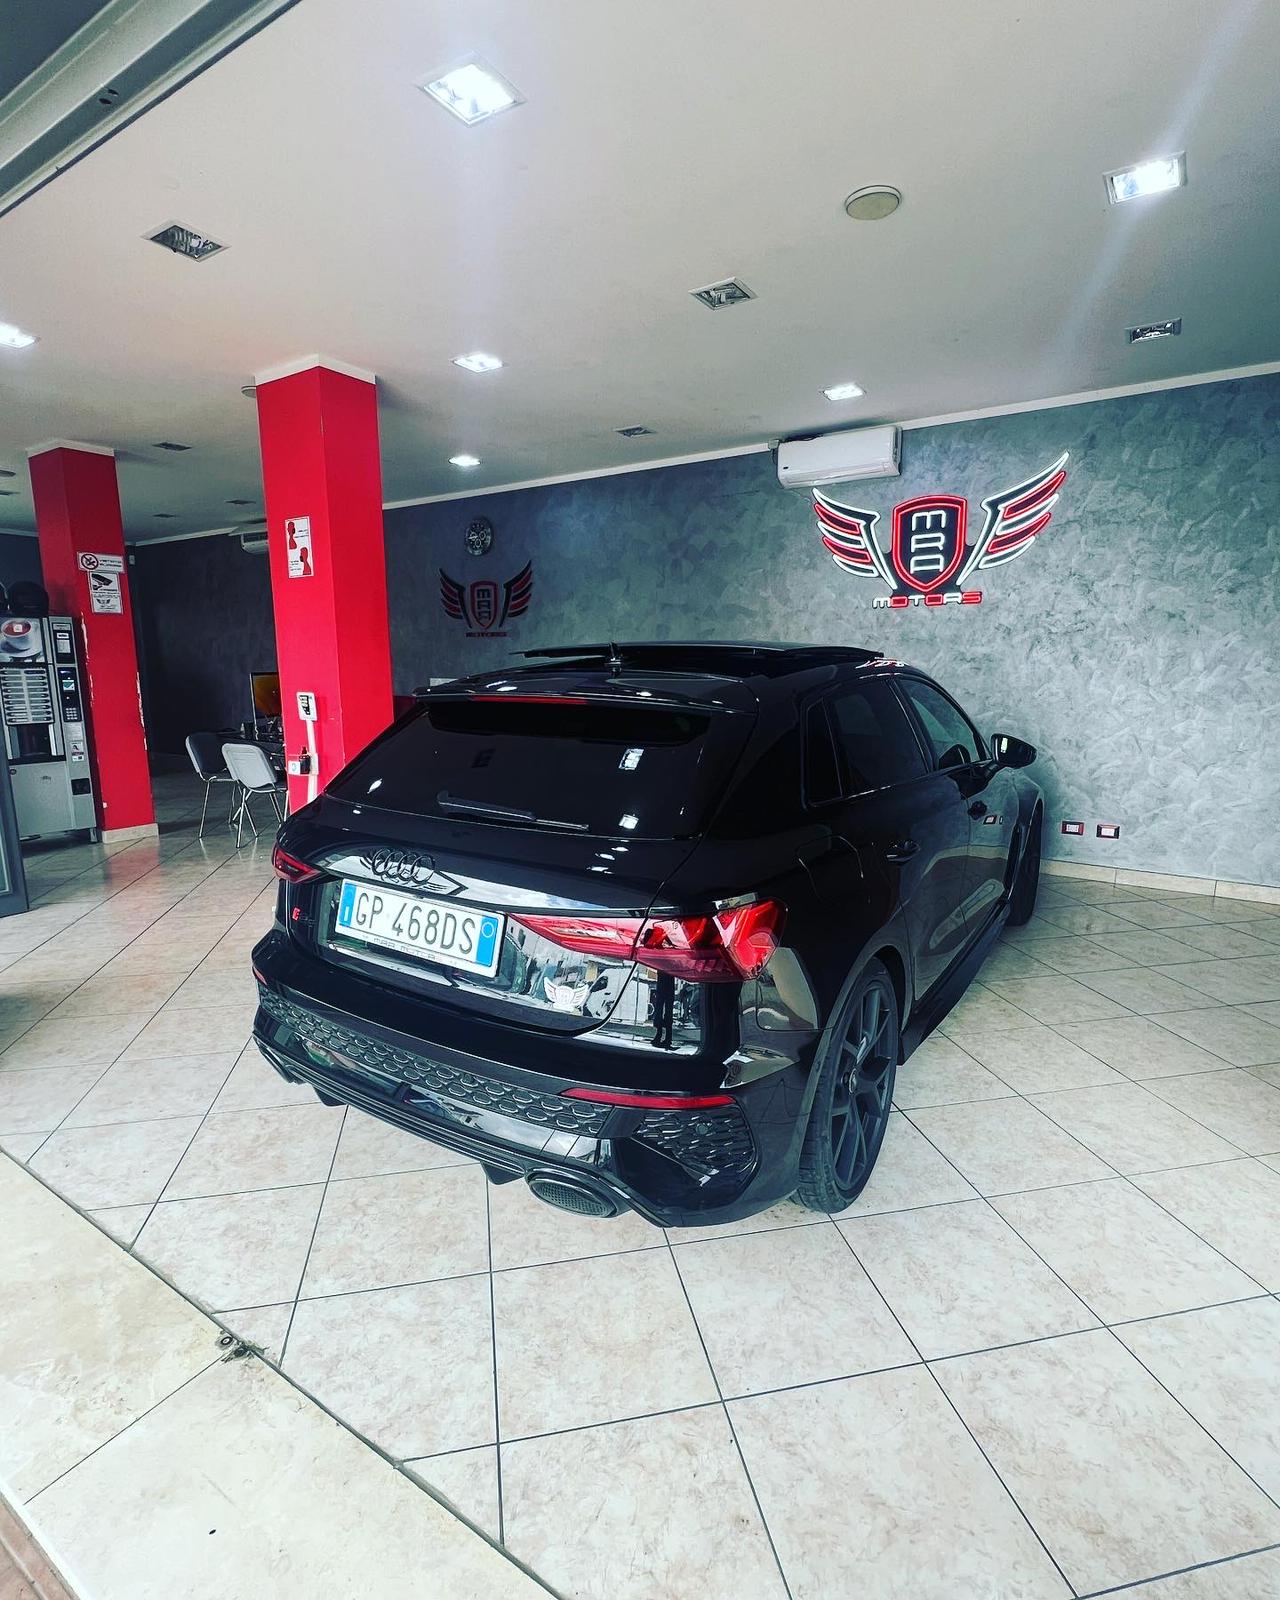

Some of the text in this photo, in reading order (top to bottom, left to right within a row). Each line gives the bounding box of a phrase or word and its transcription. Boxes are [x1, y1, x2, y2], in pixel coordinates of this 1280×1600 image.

[911, 510, 946, 574] MRA
[872, 591, 982, 608] MOTORS
[356, 892, 384, 929] GP
[392, 903, 476, 955] 468DS
